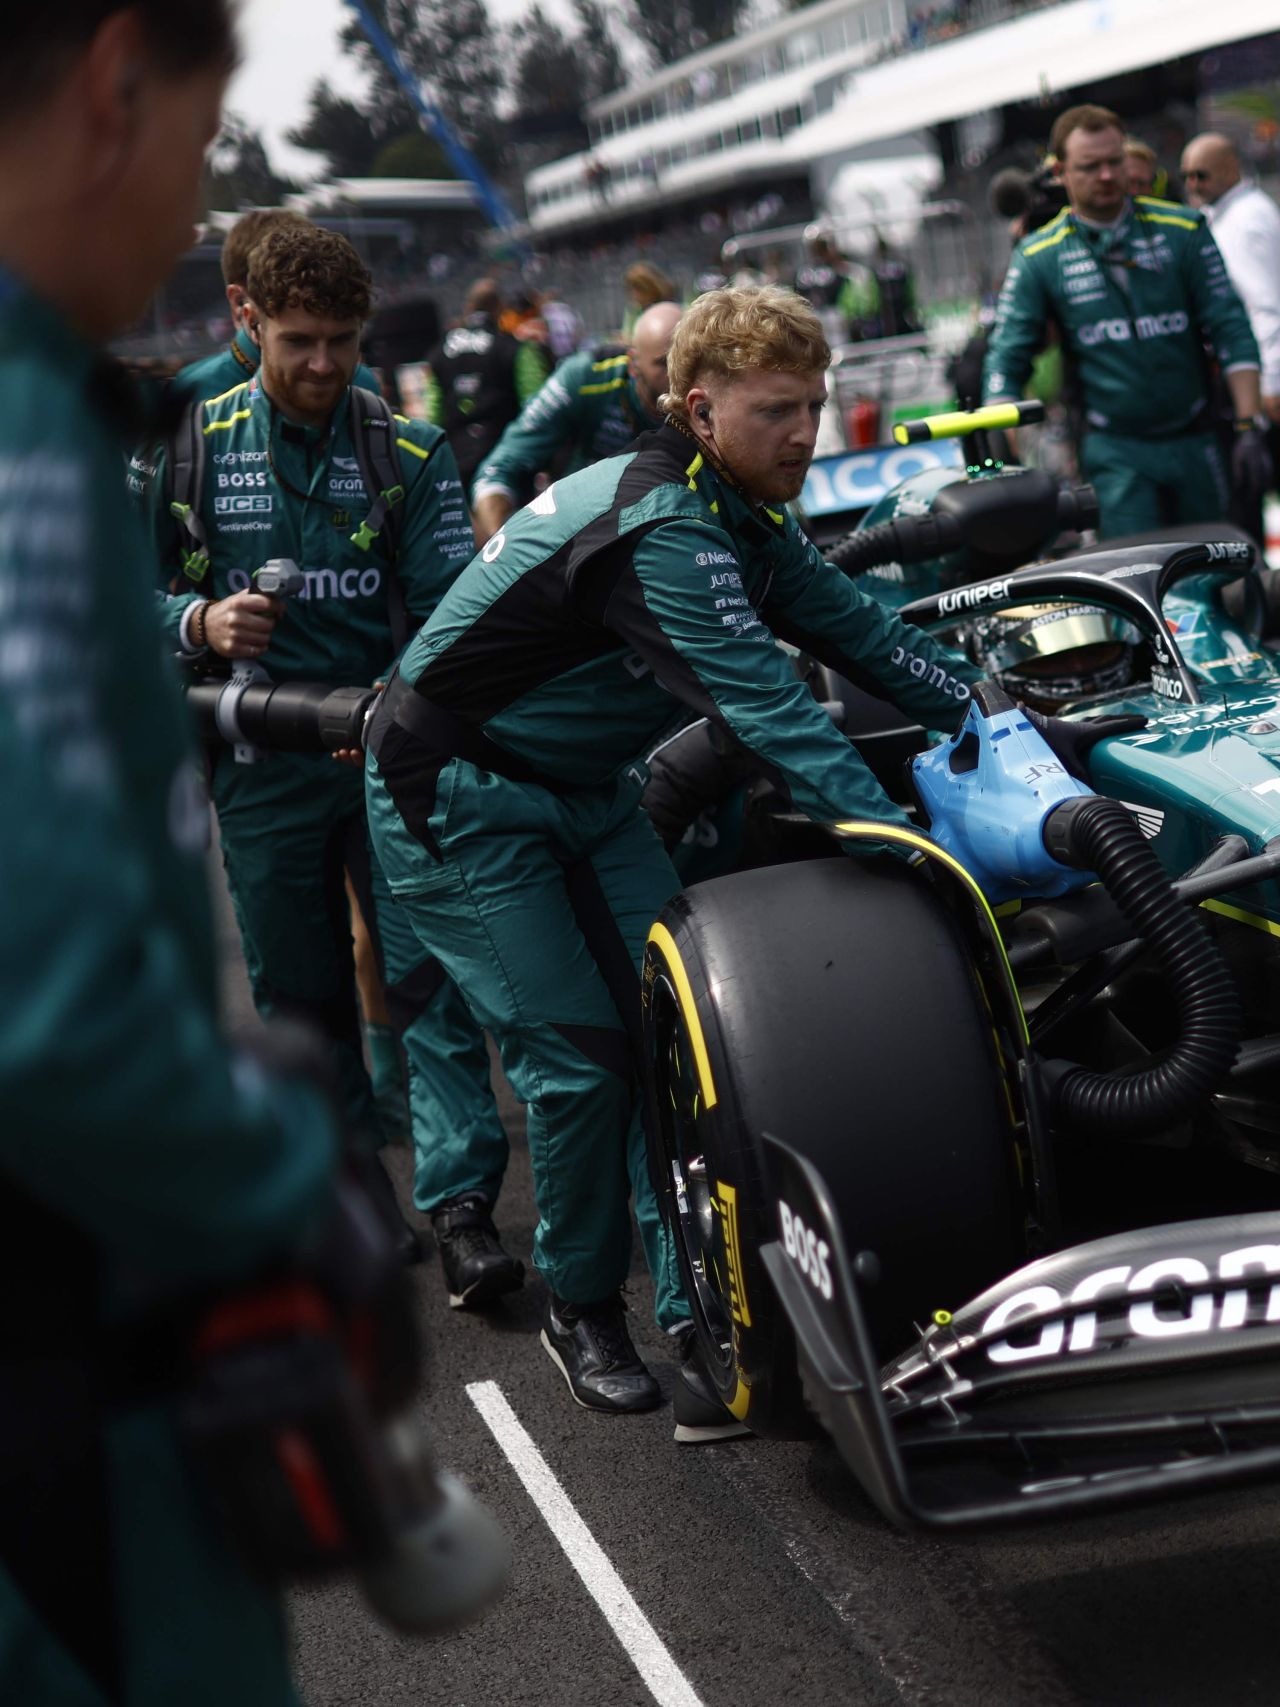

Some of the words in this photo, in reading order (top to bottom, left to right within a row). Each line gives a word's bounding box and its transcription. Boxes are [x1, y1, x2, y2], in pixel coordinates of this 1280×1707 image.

[217, 471, 267, 488] BOSS
[892, 646, 971, 701] aramco
[1024, 761, 1065, 785] RF
[716, 1178, 752, 1328] PIRELLI
[779, 1199, 834, 1301] BOSS
